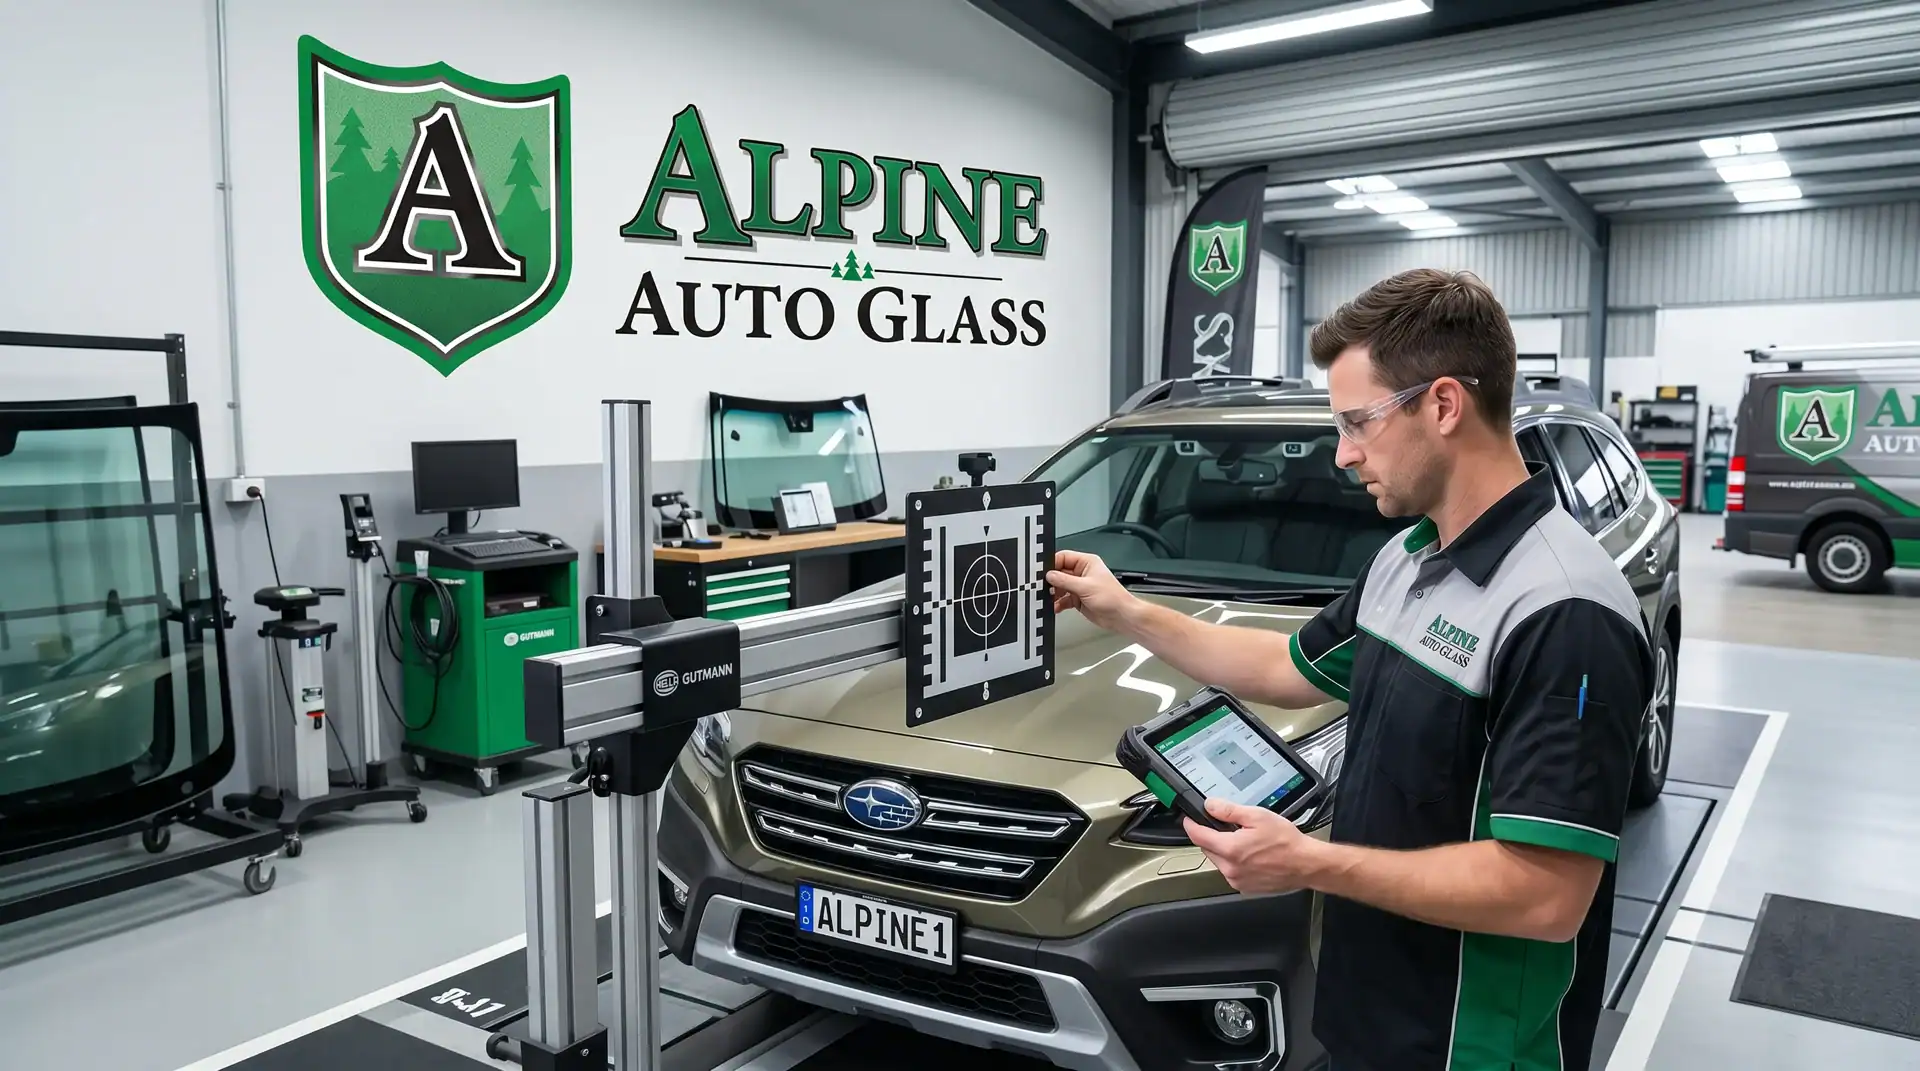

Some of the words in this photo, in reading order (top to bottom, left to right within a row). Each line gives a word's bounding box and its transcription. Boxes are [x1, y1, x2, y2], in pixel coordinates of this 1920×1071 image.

[356, 103, 524, 280] A
[620, 104, 1048, 257] ALPINE
[1197, 232, 1235, 274] A
[615, 270, 836, 341] AUTO
[857, 285, 1047, 347] GLASS
[1788, 396, 1840, 442] A
[1862, 434, 1920, 454] AUT
[1419, 636, 1441, 652] AUTO
[1440, 647, 1470, 668] GLASS
[1427, 614, 1479, 652] ALPINE
[682, 662, 733, 685] GUTMANN
[817, 896, 947, 960] ALPINE1
